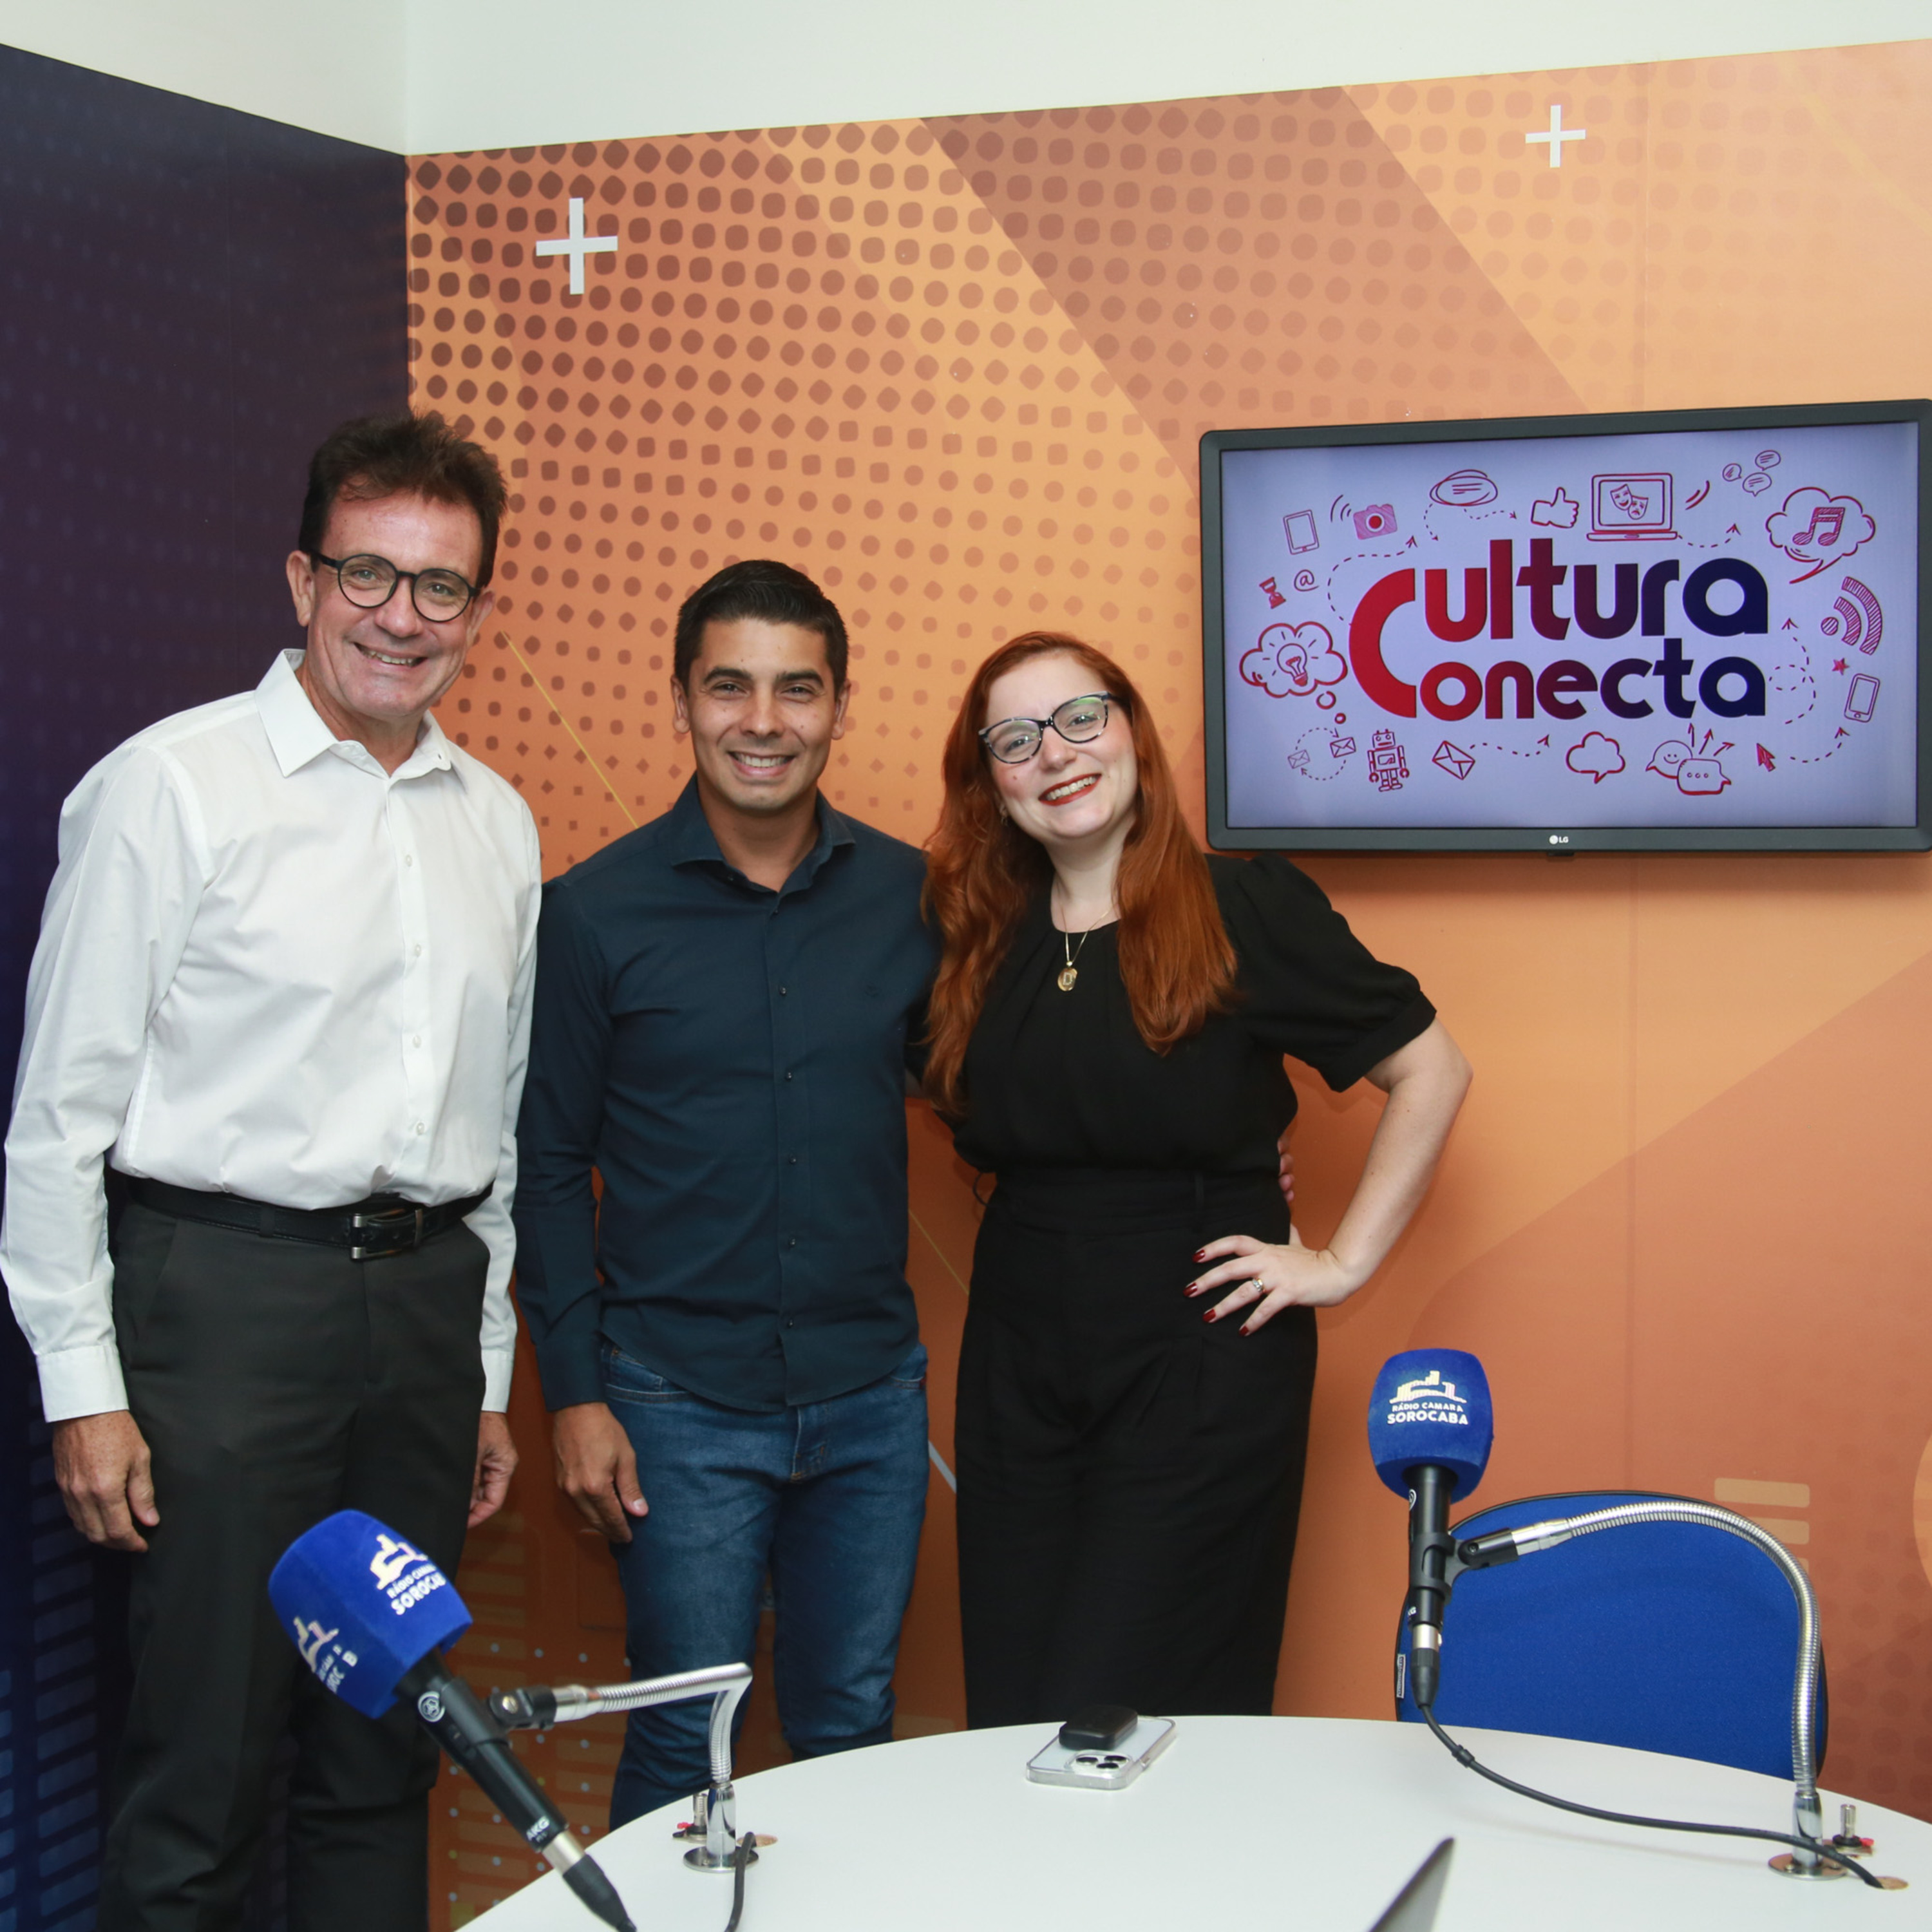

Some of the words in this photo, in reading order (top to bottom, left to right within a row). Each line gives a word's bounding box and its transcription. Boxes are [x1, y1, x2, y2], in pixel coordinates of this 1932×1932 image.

[1349, 538, 1768, 644] Cultura
[1387, 1410, 1469, 1425] SOROCABA
[526, 1815, 549, 1841] AKG
